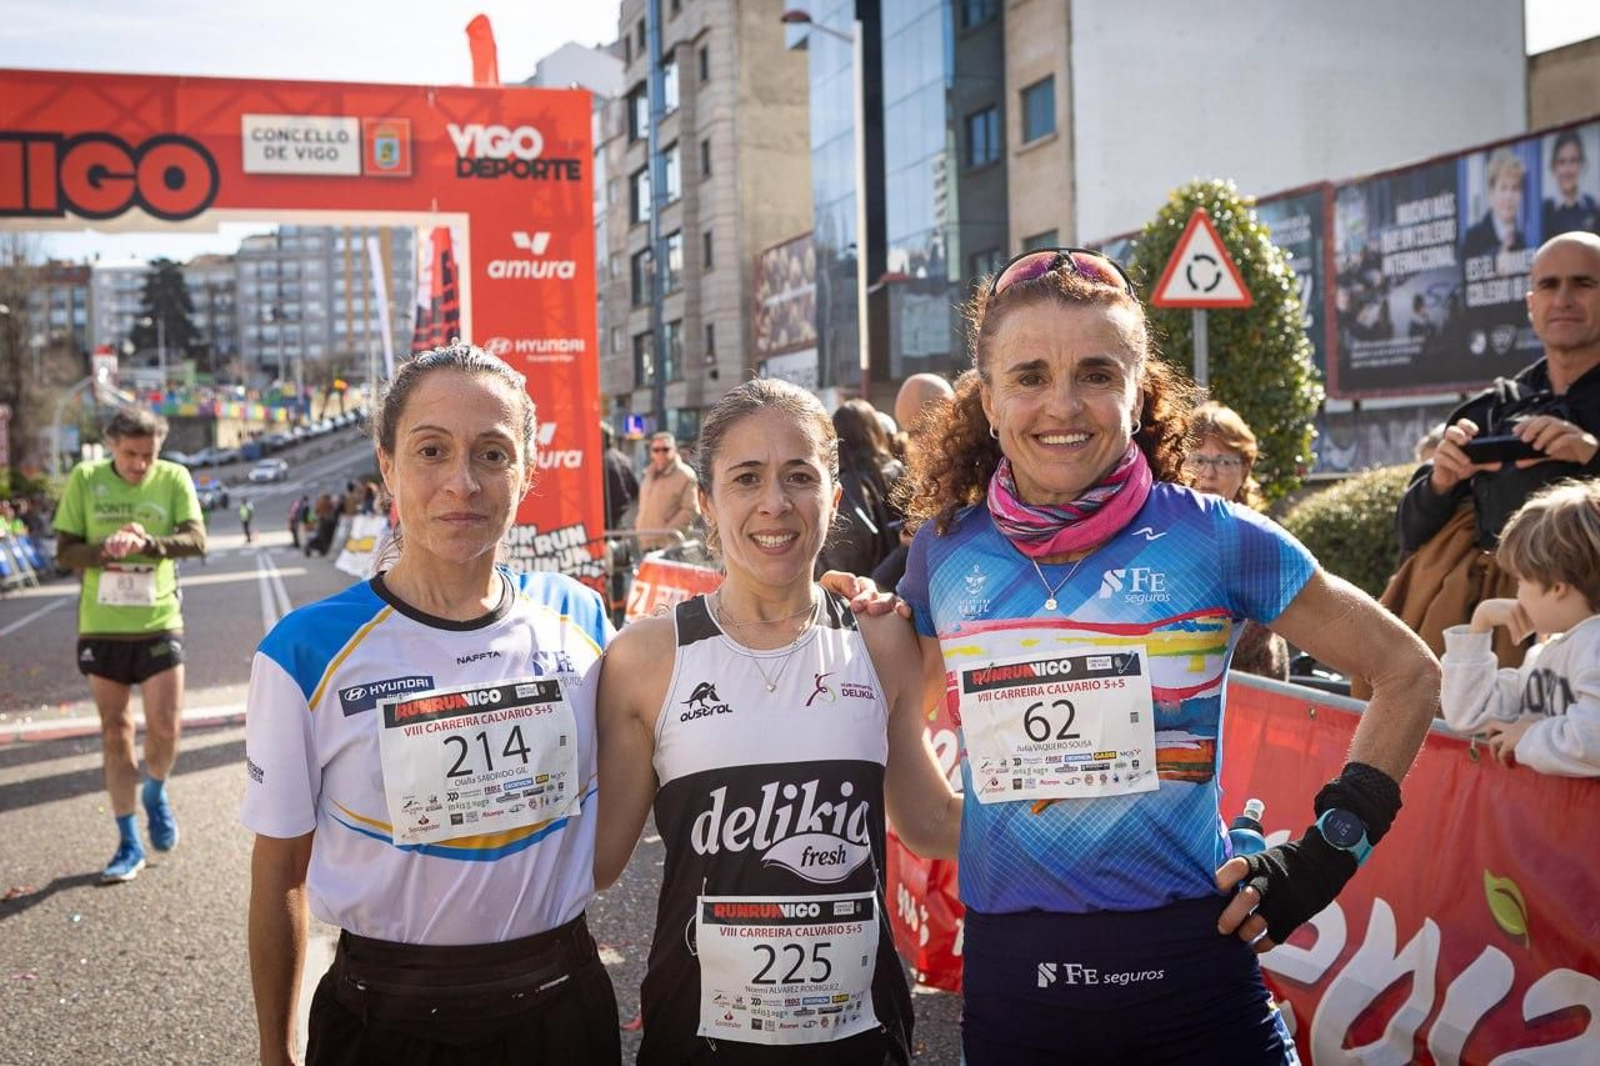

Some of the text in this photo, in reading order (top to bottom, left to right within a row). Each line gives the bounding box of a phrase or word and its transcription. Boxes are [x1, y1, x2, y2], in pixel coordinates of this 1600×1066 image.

[251, 127, 351, 146] CONCELLO
[446, 123, 544, 161] VIGO
[263, 146, 340, 163] DE VIGO
[456, 156, 582, 182] DEPORTE
[487, 256, 576, 280] amura
[515, 339, 585, 353] HYUNDAI
[538, 450, 583, 469] ura
[1130, 567, 1166, 591] FE
[1124, 591, 1171, 604] seguros
[457, 651, 500, 665] NAFFTA
[369, 678, 431, 695] HYUNDAI
[842, 688, 876, 700] DELIKIA
[978, 678, 1126, 702] VIII CARREIRA CALVARIO 5+5
[404, 704, 553, 737] VIII CARREIRA CALVARIO 5+5
[680, 703, 733, 722] austral
[1023, 699, 1081, 743] 62
[443, 725, 531, 778] 214
[1033, 741, 1068, 751] VAQUERO
[1069, 739, 1092, 749] SOUSA
[690, 779, 869, 855] delikia
[801, 845, 847, 867] fresh
[720, 924, 862, 938] VIII CARREIRA CALVARIO 5+5
[751, 942, 832, 984] 225
[1064, 963, 1164, 985] FE seguros
